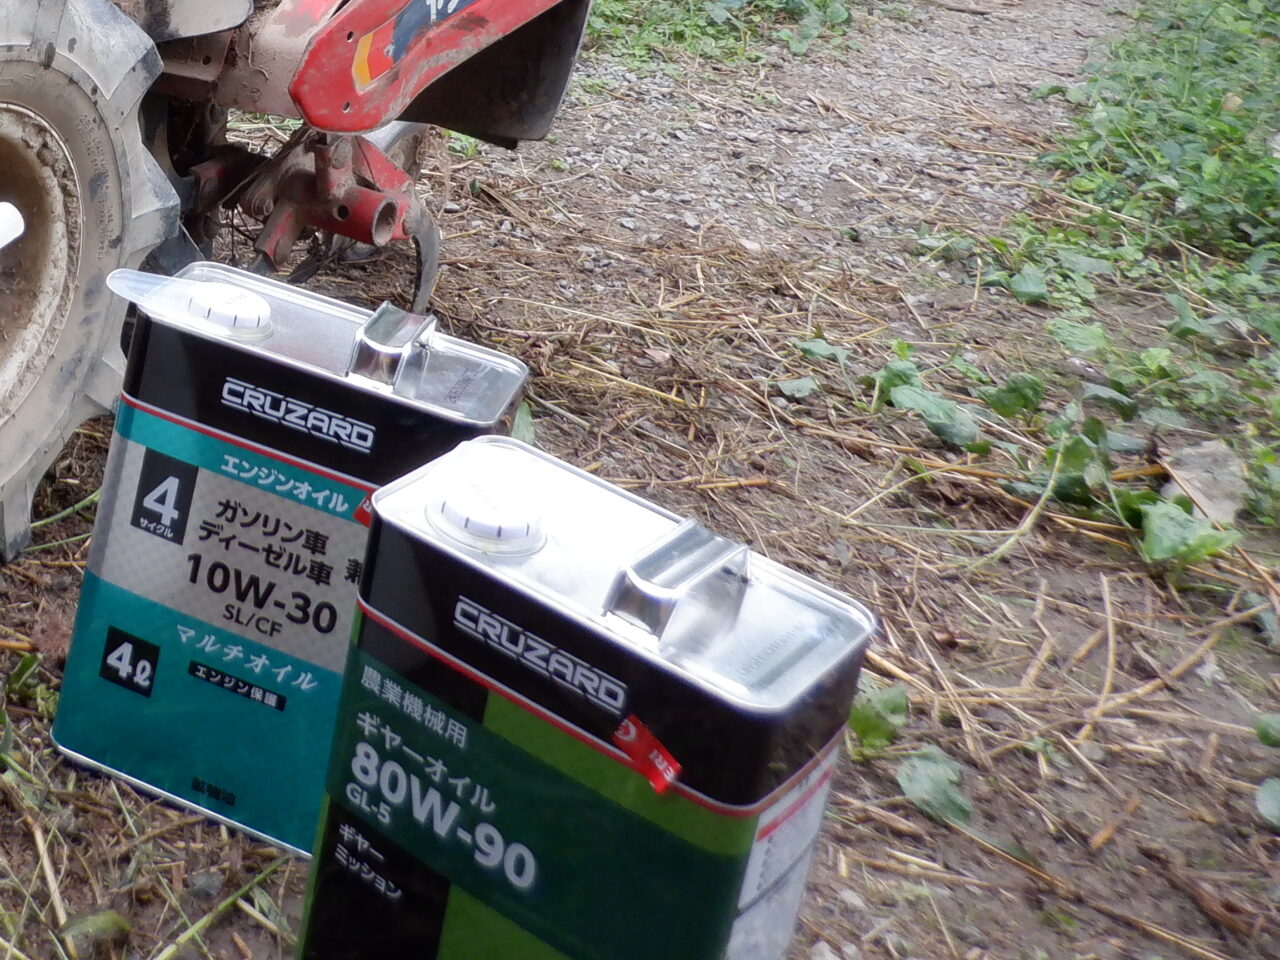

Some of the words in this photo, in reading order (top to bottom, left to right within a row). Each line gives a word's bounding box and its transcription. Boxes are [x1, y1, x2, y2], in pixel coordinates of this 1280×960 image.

[221, 377, 376, 452] CRUZARD
[143, 476, 179, 527] 4
[221, 454, 349, 513] エンジンオイル
[140, 517, 173, 537] サイクル
[199, 520, 334, 586] ディーゼル車
[215, 498, 330, 556] ガソリン車
[187, 553, 338, 634] 10W-30
[223, 603, 283, 637] SL/CF
[177, 624, 319, 690] マルチオイル
[453, 595, 628, 715] CRUZARD
[195, 665, 279, 708] エンジン保護
[361, 666, 468, 749] 農業機械用
[356, 711, 496, 813] ギヤーオイル
[346, 782, 391, 824] GL-5
[351, 741, 537, 888] 80W-90
[333, 843, 402, 899] ミッション
[339, 823, 385, 862] ギヤー
